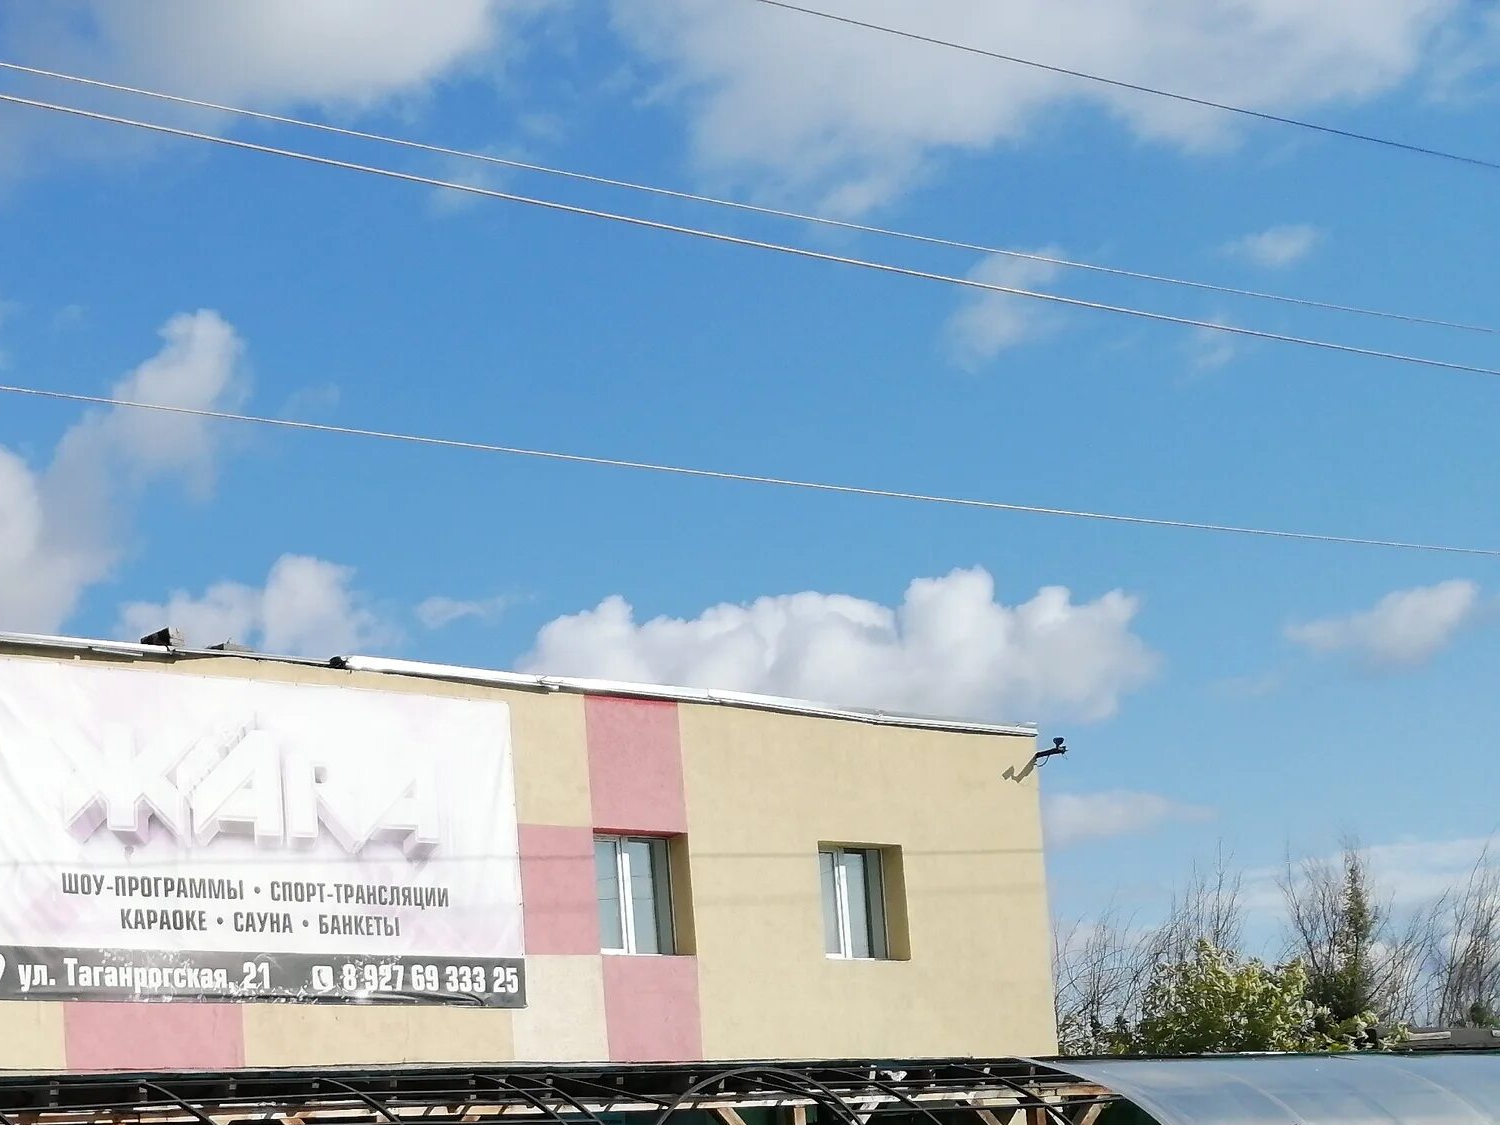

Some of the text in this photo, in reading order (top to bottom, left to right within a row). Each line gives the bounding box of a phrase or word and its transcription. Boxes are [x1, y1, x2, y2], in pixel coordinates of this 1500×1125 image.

[62, 872, 450, 910] ШОУ-ПРОГРАММЫ СПОРТ-ТРАНСЛЯЦИИ
[120, 908, 401, 937] КАРАОКЕ САУНА БАНКЕТЫ
[17, 957, 271, 995] ул. Таганрогская, 21
[342, 963, 519, 994] 8 927 69 333 25
